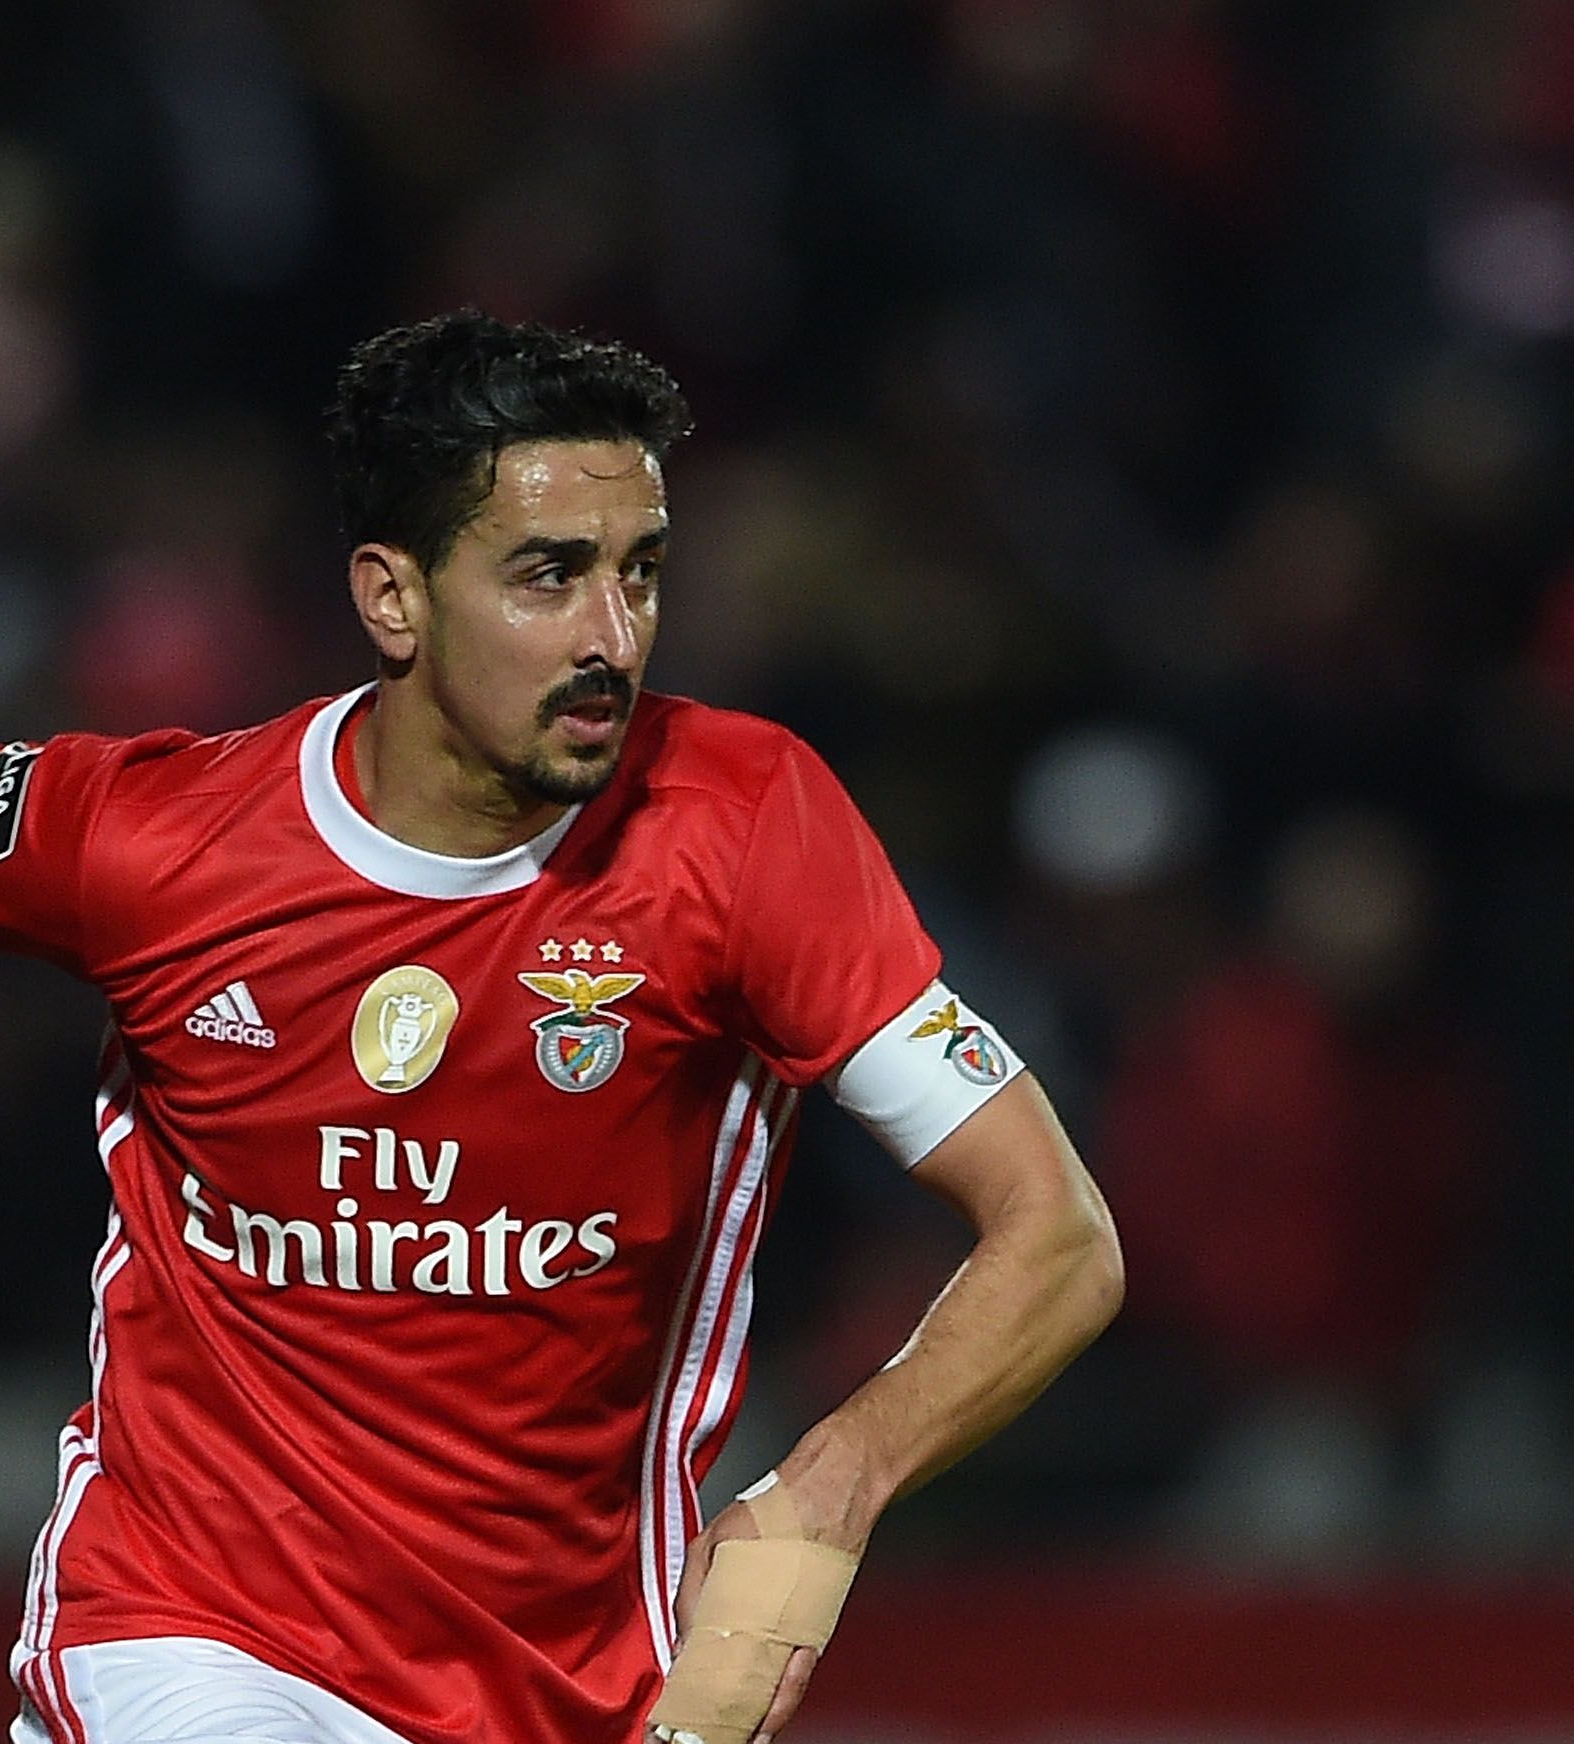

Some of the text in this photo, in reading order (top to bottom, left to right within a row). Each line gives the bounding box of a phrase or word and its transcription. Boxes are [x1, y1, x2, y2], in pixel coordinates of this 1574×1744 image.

[185, 1016, 276, 1048] adidas
[319, 1126, 460, 1204] Fly
[181, 1172, 618, 1296] Emirates
